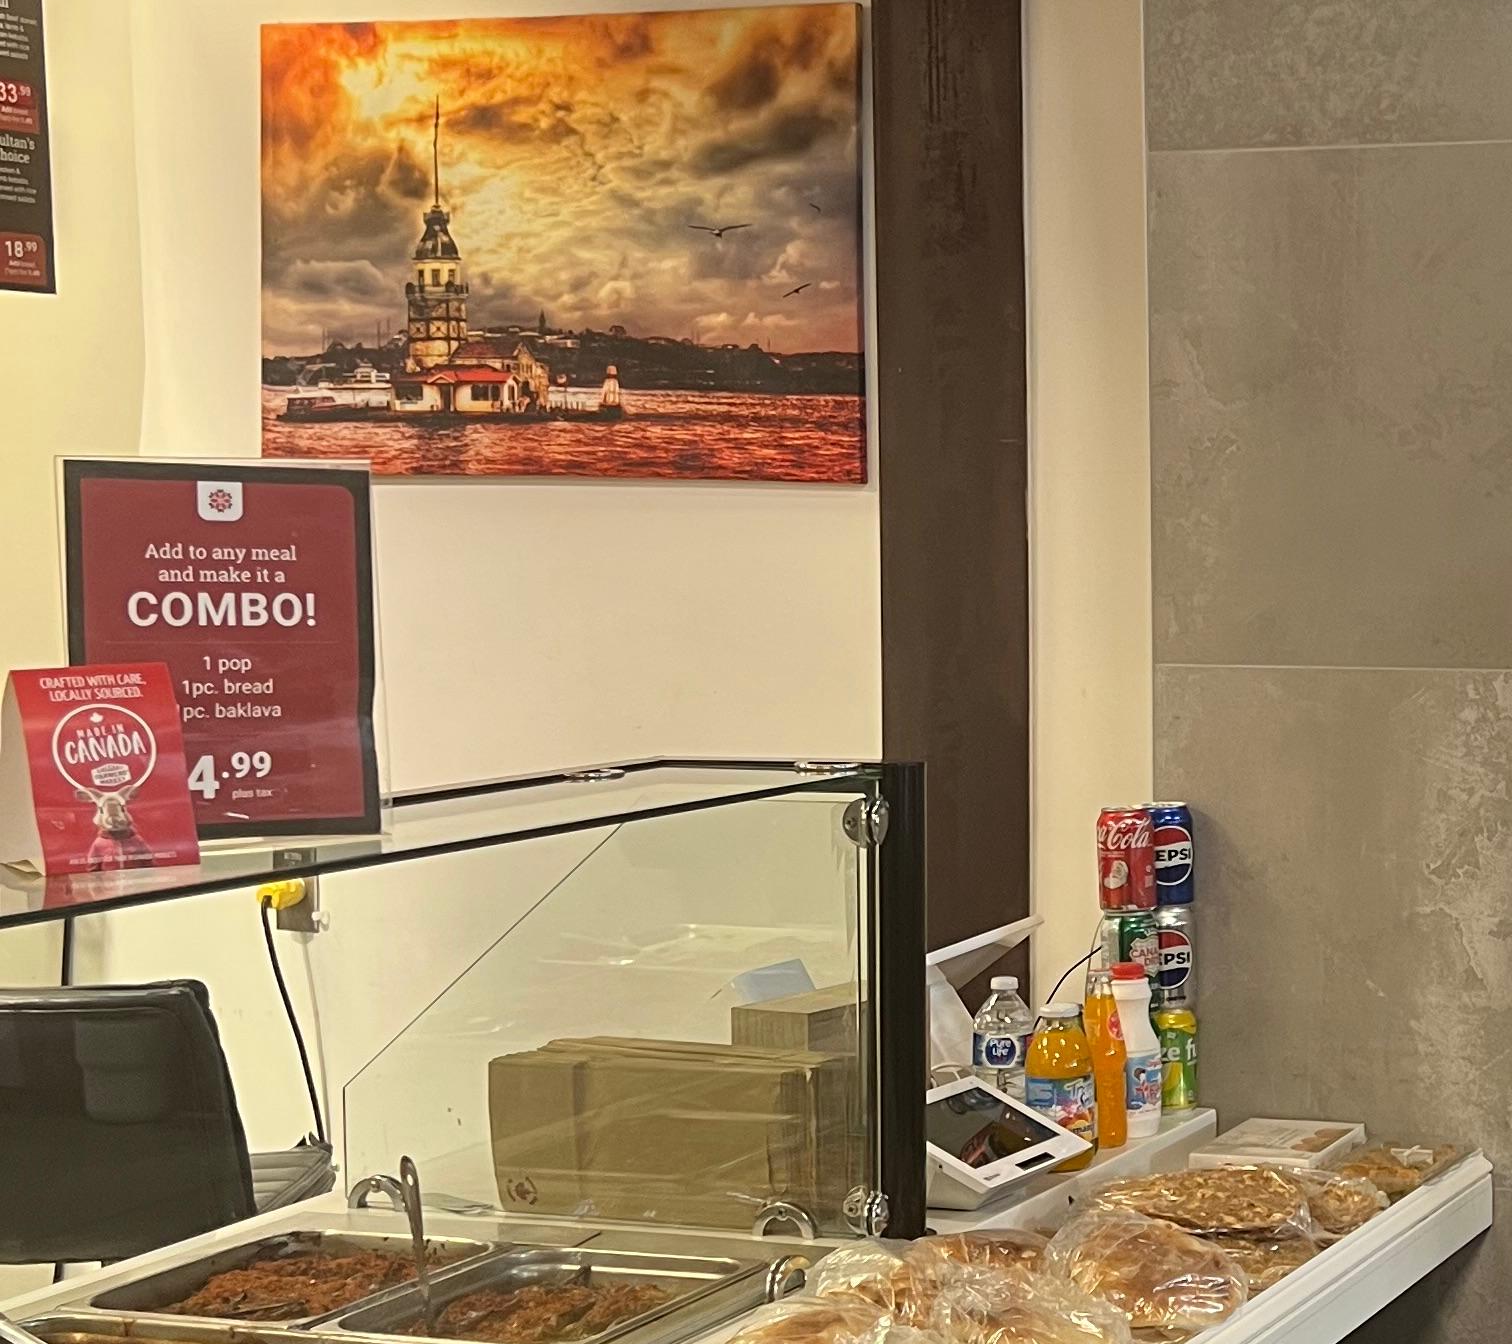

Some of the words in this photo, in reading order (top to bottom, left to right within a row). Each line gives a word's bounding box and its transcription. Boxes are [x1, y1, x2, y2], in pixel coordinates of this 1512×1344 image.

[4, 240, 38, 258] 18.99
[144, 542, 184, 560] Add
[189, 544, 207, 560] to
[211, 546, 247, 564] any
[251, 545, 297, 561] meal
[158, 565, 195, 583] and
[199, 566, 252, 583] make
[256, 567, 270, 583] it
[274, 570, 286, 583] a
[127, 590, 317, 627] COMBO!
[203, 656, 211, 671] 1
[218, 658, 252, 674] pop
[39, 675, 85, 689] CRAFTED
[87, 674, 115, 687] WITH
[182, 679, 219, 698] 1pc.
[224, 678, 274, 694] bread
[49, 688, 92, 702] LOCALLY
[215, 702, 282, 718] baklava
[76, 727, 109, 739] MADE
[111, 723, 125, 734] IN
[64, 731, 147, 765] CANADA
[187, 751, 272, 799] 4.99
[232, 787, 254, 800] plus
[256, 788, 273, 798] tax
[1155, 847, 1191, 862] EPSI
[1159, 951, 1190, 966] PSI
[989, 1038, 1011, 1047] Pure
